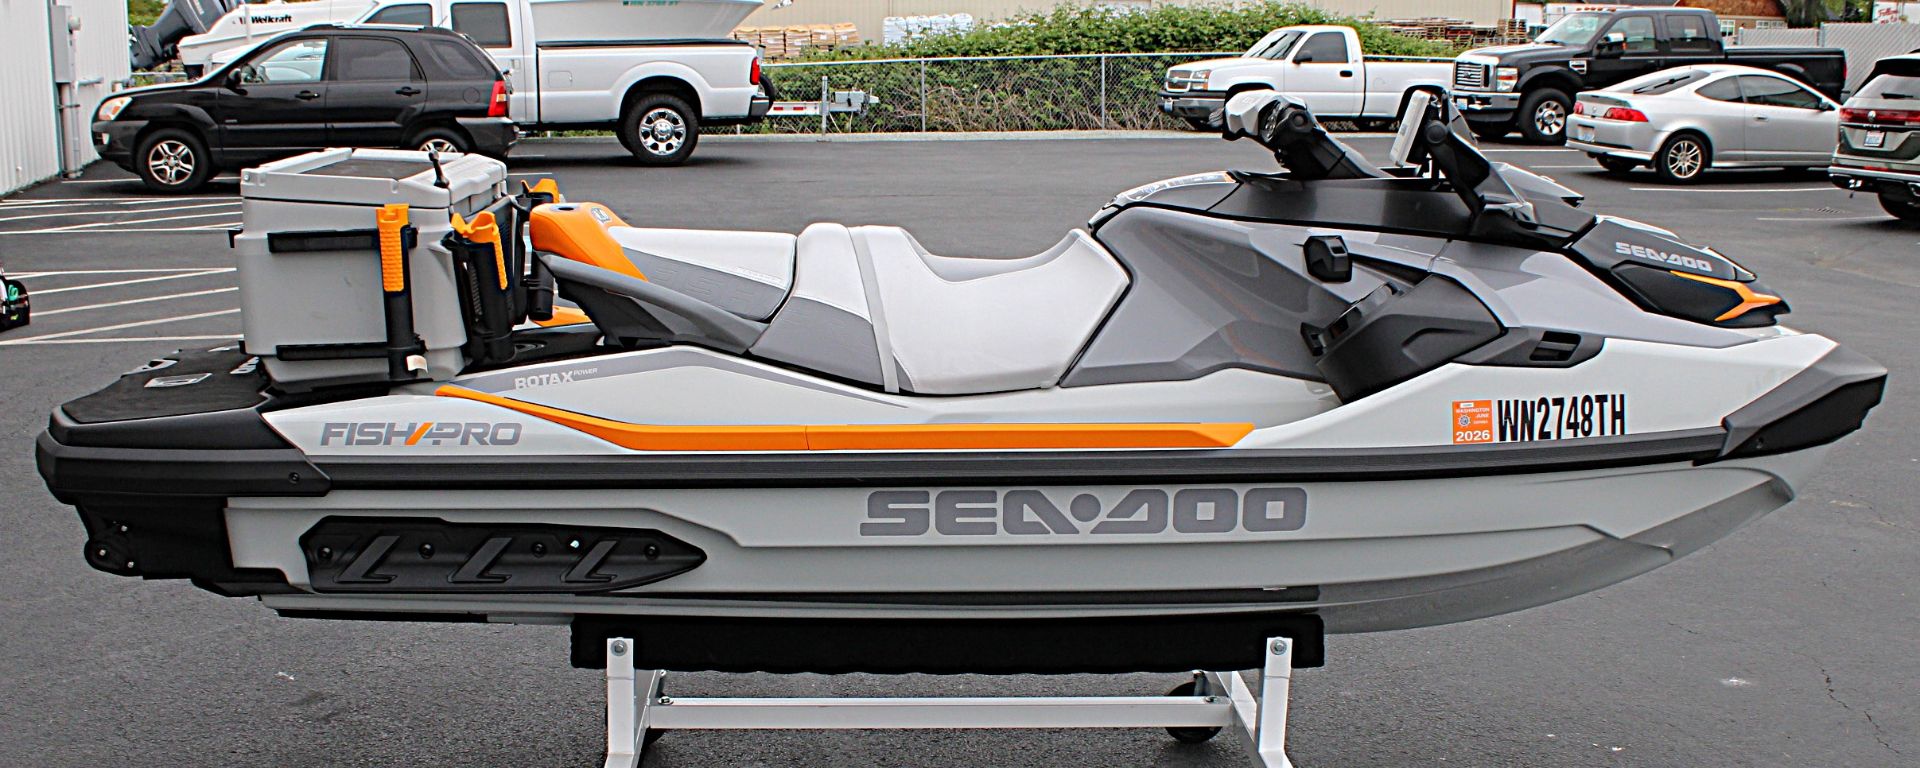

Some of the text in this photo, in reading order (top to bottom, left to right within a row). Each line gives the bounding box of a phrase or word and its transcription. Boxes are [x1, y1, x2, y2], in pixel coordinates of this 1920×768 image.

[251, 14, 292, 24] Wellcraft
[514, 367, 599, 390] ROTAX POWER
[1497, 394, 1625, 442] WN2748TH
[1455, 430, 1491, 442] 2026
